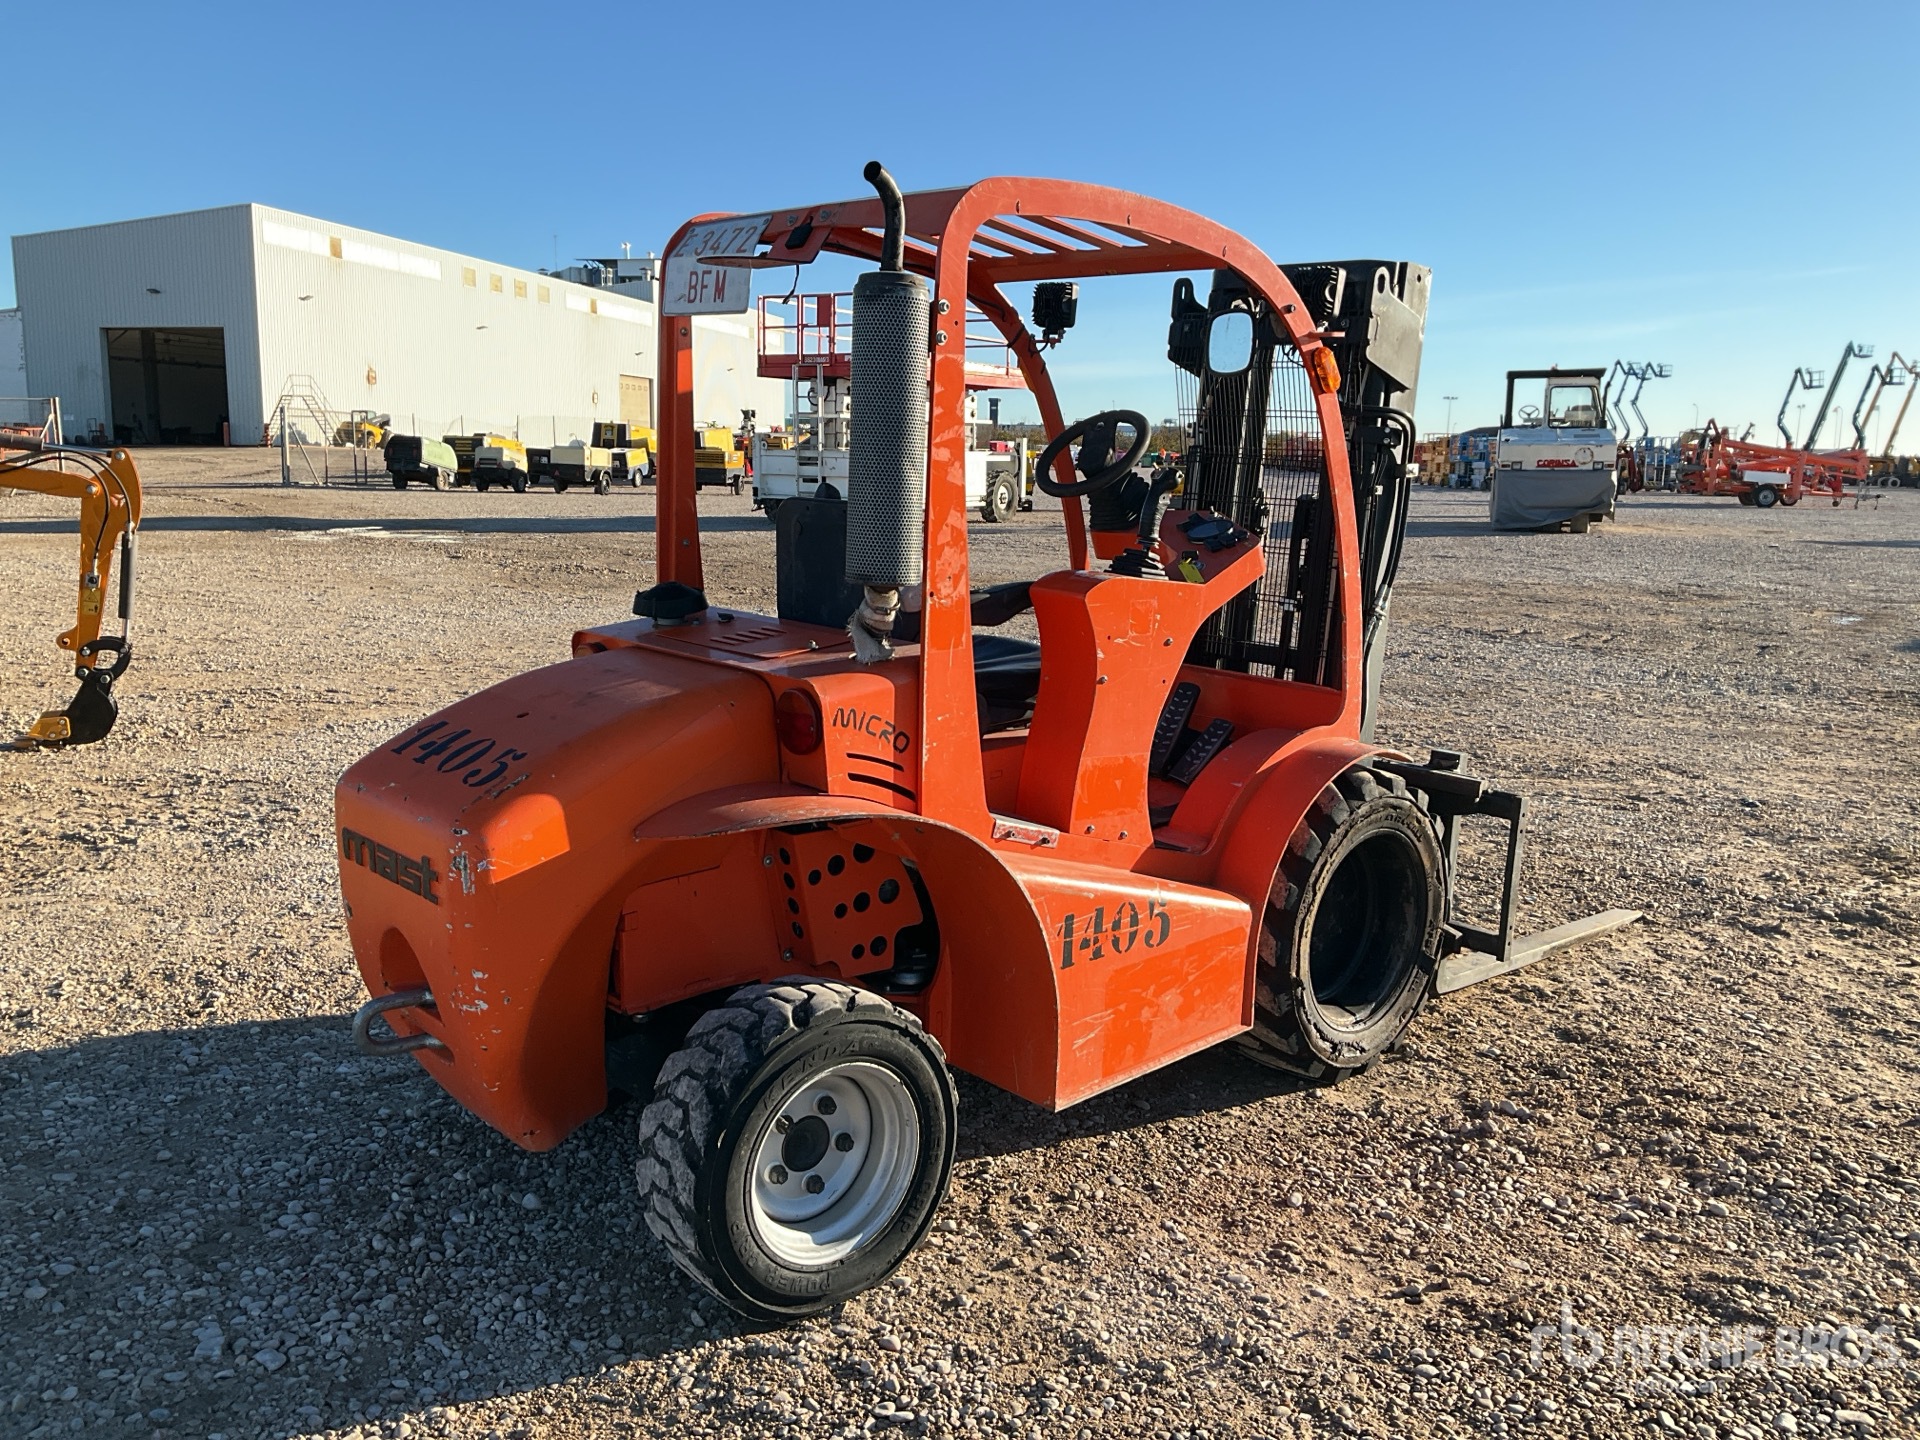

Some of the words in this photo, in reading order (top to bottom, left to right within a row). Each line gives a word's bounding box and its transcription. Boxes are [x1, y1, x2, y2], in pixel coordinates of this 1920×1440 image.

[695, 226, 757, 256] 3472
[688, 270, 727, 303] BFM
[391, 720, 528, 788] 1405
[832, 707, 910, 753] MICRO
[341, 826, 439, 906] mast
[1057, 899, 1171, 970] 1405
[763, 1040, 860, 1111] KENDA
